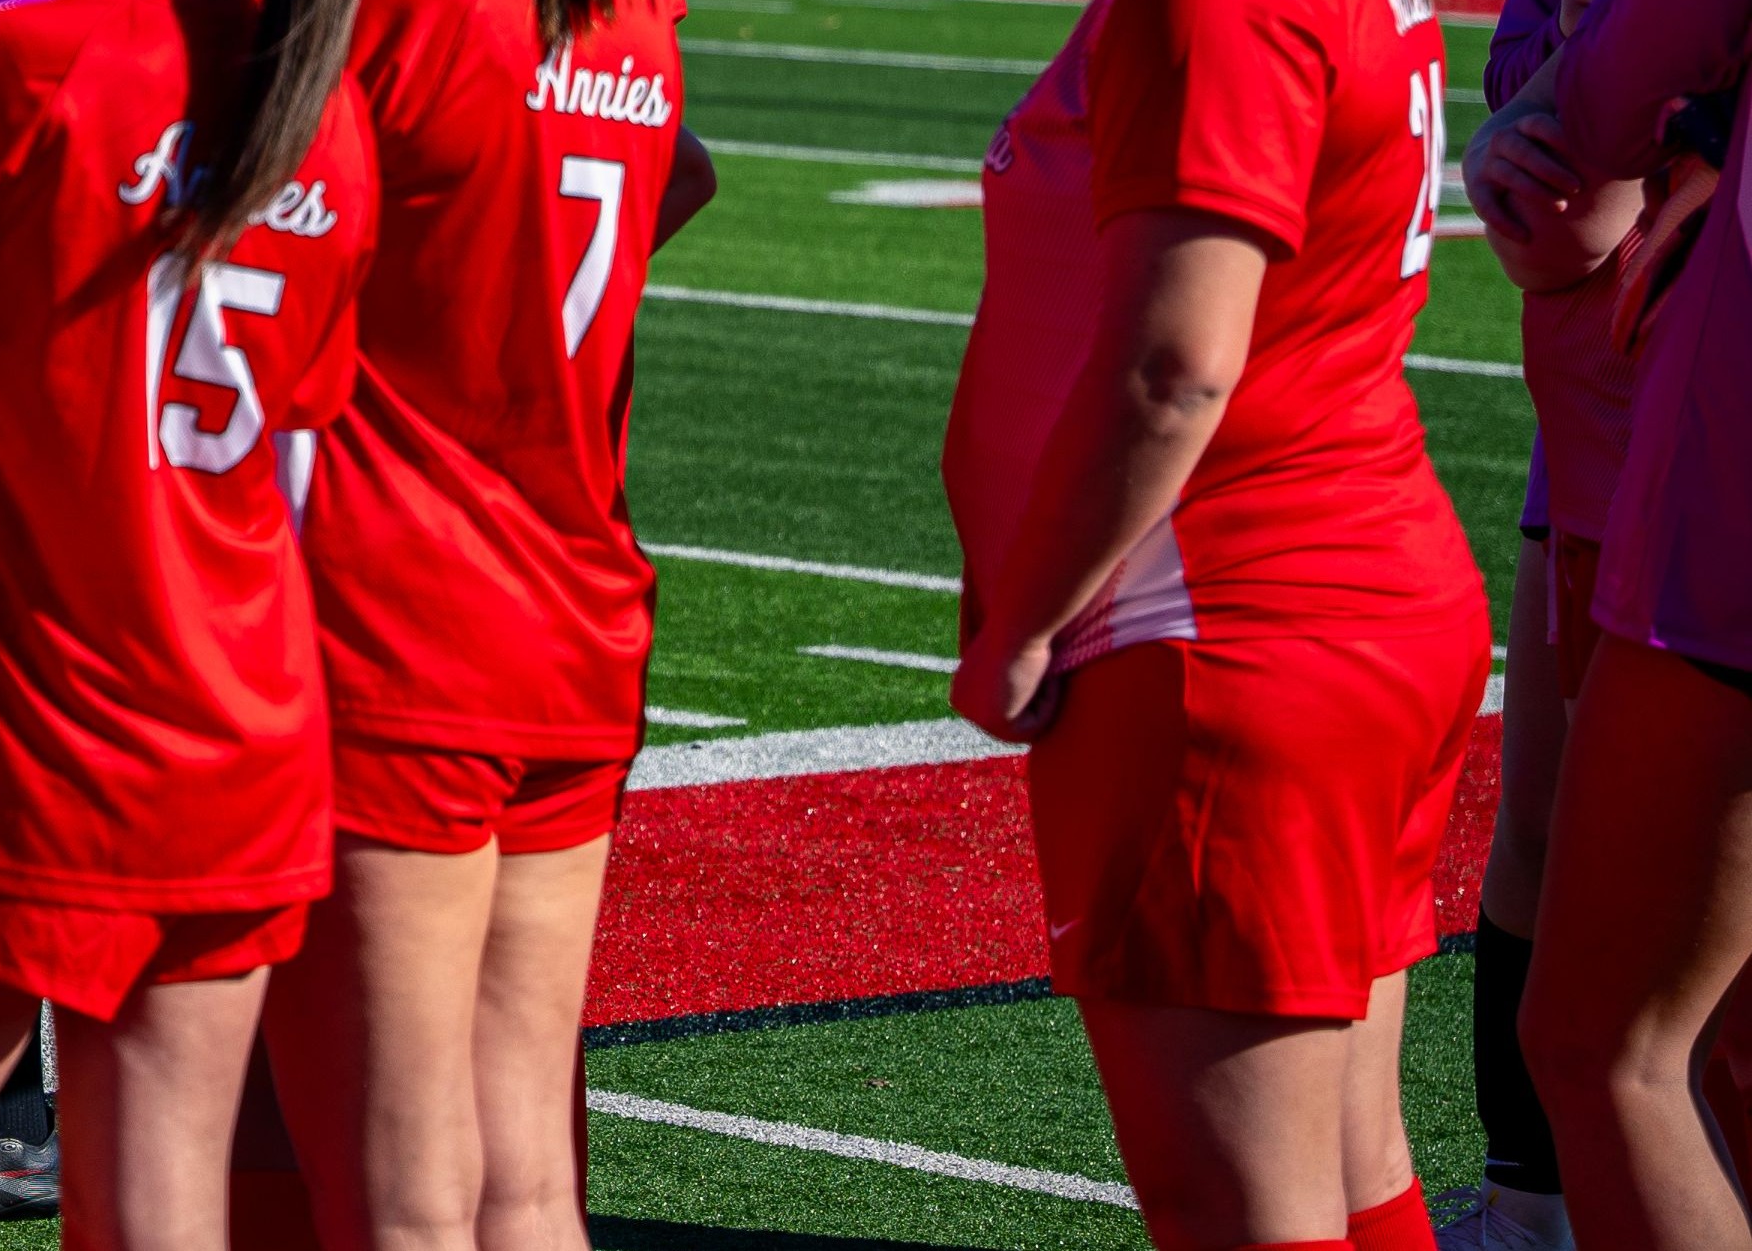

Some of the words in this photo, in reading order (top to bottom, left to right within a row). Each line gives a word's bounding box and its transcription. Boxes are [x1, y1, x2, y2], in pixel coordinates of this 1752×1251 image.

[526, 36, 673, 128] Annies
[118, 119, 339, 237] Aes
[559, 154, 626, 361] 7
[146, 251, 286, 474] 15
